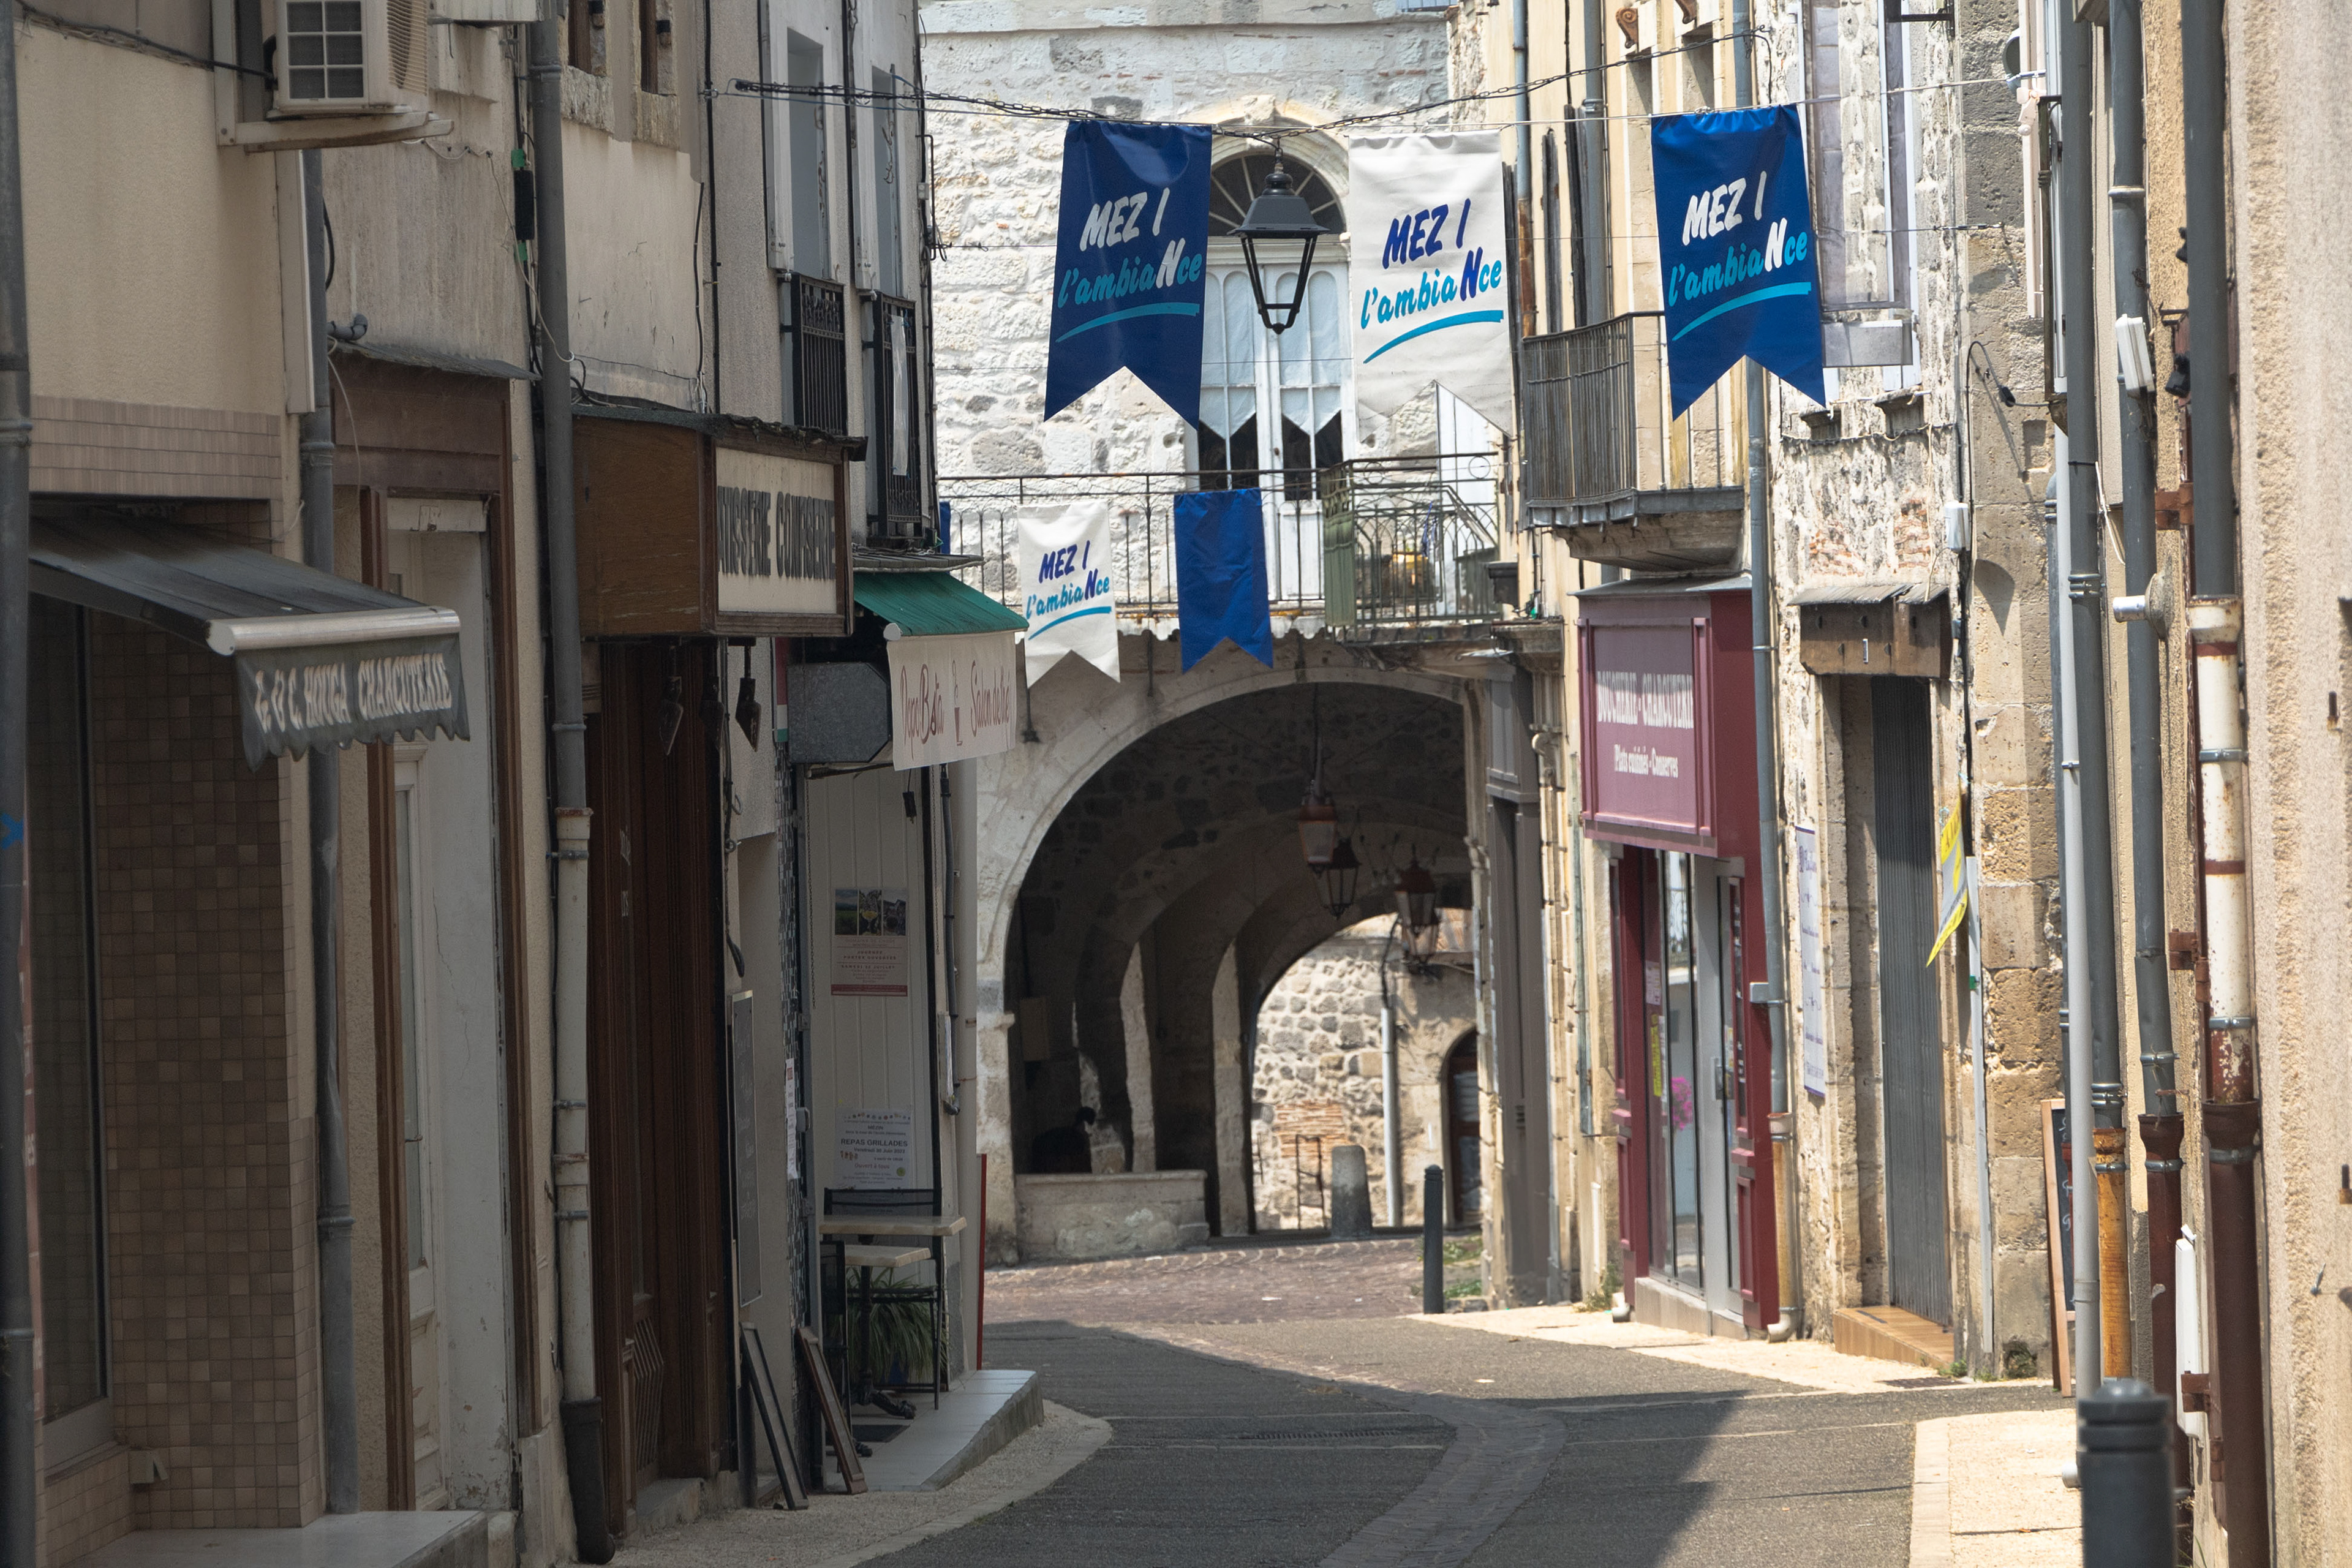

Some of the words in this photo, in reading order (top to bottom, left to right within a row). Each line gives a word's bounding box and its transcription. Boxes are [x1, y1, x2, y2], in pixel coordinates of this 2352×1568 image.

[1079, 192, 1148, 251] MEZ
[1382, 203, 1449, 269] MEZ
[1682, 177, 1747, 246] MEZ
[1057, 240, 1202, 309] l'ambiaNce
[1360, 246, 1502, 329] l'ambiaNce
[1668, 217, 1809, 307] l'ambiaNce
[717, 485, 771, 576] ATISSERIE
[776, 491, 836, 581] CONFISERIE
[1038, 544, 1078, 583] MEZ
[1026, 569, 1110, 620] l'ambiaNce
[358, 653, 452, 720] CHARCUTERIE
[1597, 671, 1638, 725] BOUCHERIE
[1641, 673, 1694, 729] CHARCUTERIE
[1614, 744, 1628, 772] Plats
[1652, 747, 1678, 778] Conserves
